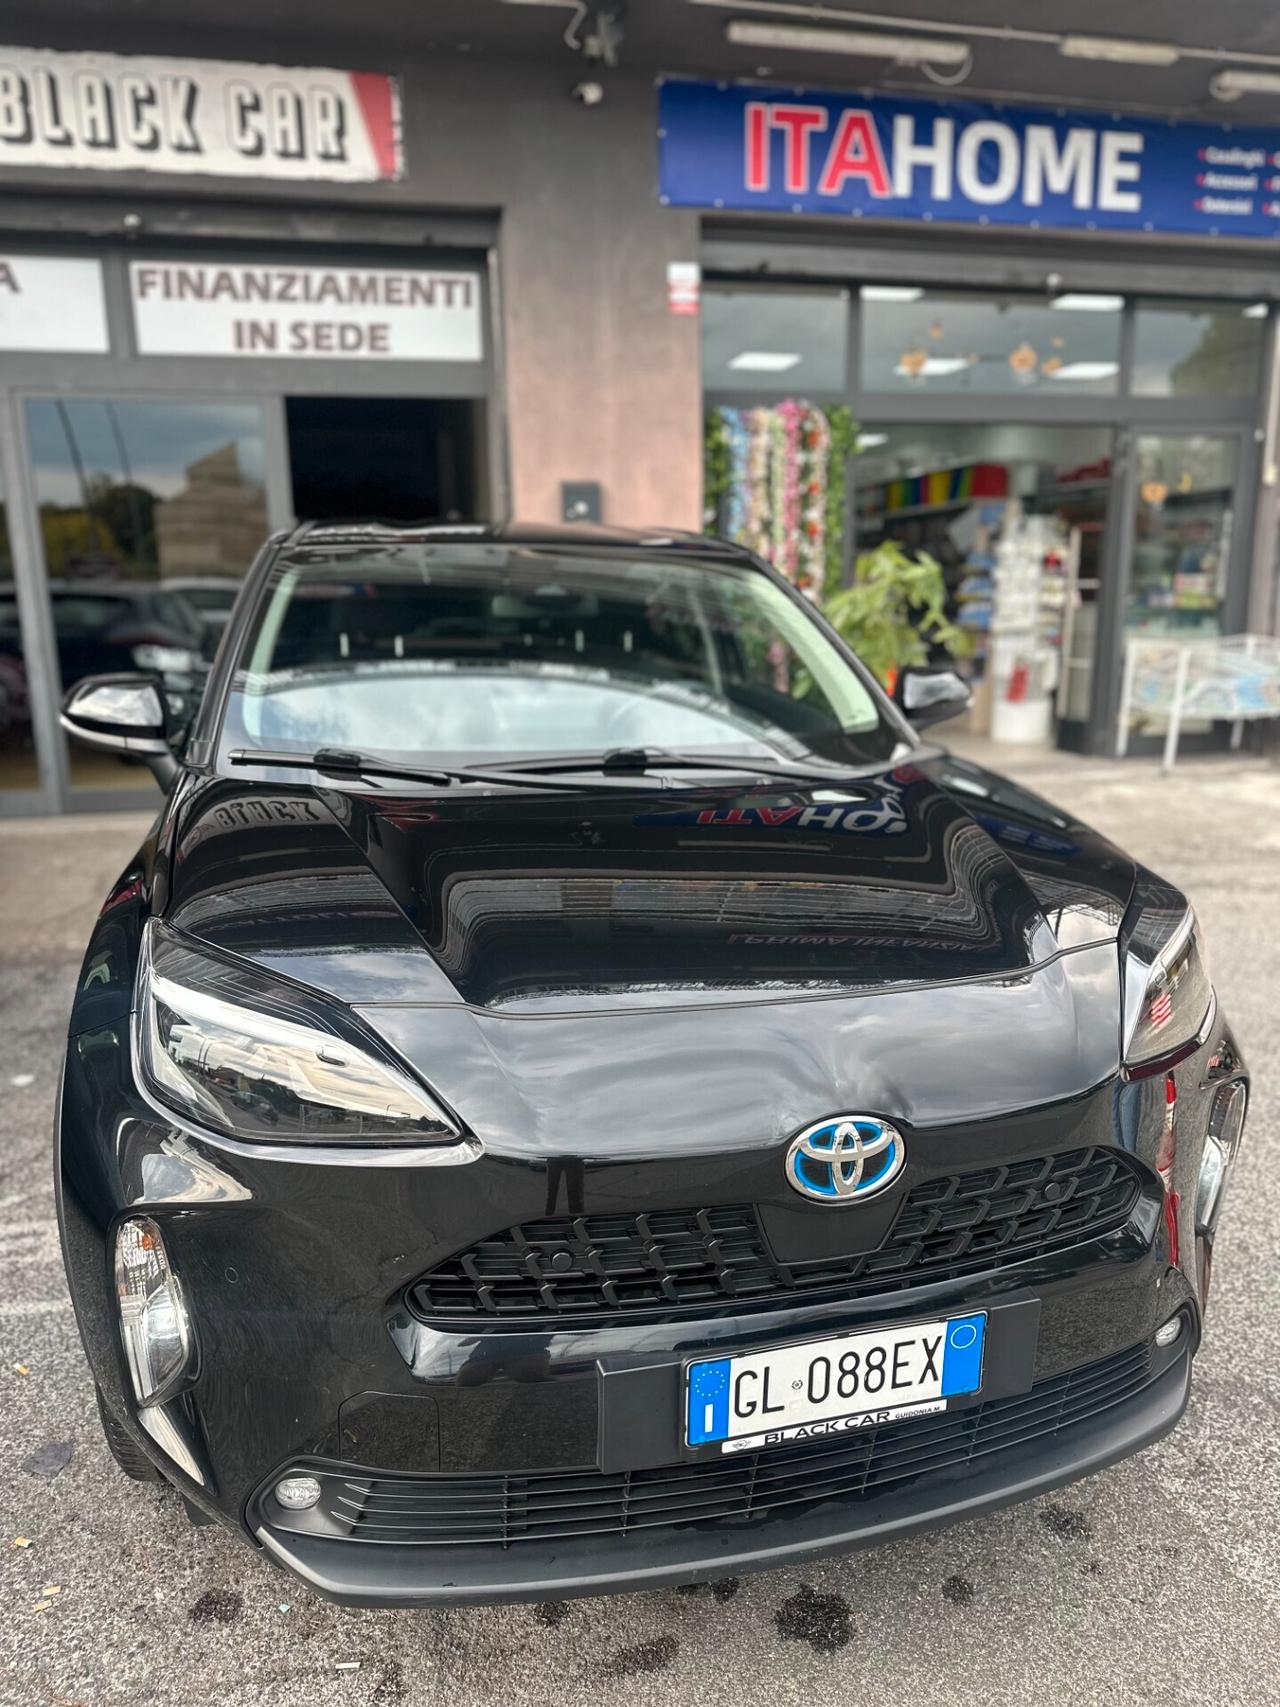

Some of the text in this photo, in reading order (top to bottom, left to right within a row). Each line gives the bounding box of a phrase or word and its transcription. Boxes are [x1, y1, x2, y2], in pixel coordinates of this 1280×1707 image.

[0, 65, 347, 161] BLACK CAR
[744, 101, 1144, 212] ITAHOME
[137, 268, 473, 308] FINANZIAMENTI
[234, 320, 390, 352] IN SEDE
[734, 1335, 943, 1418] GL 088EX
[764, 1421, 839, 1444] BLACK
[844, 1411, 890, 1429] CAR
[895, 1407, 932, 1419] GUIDONIA
